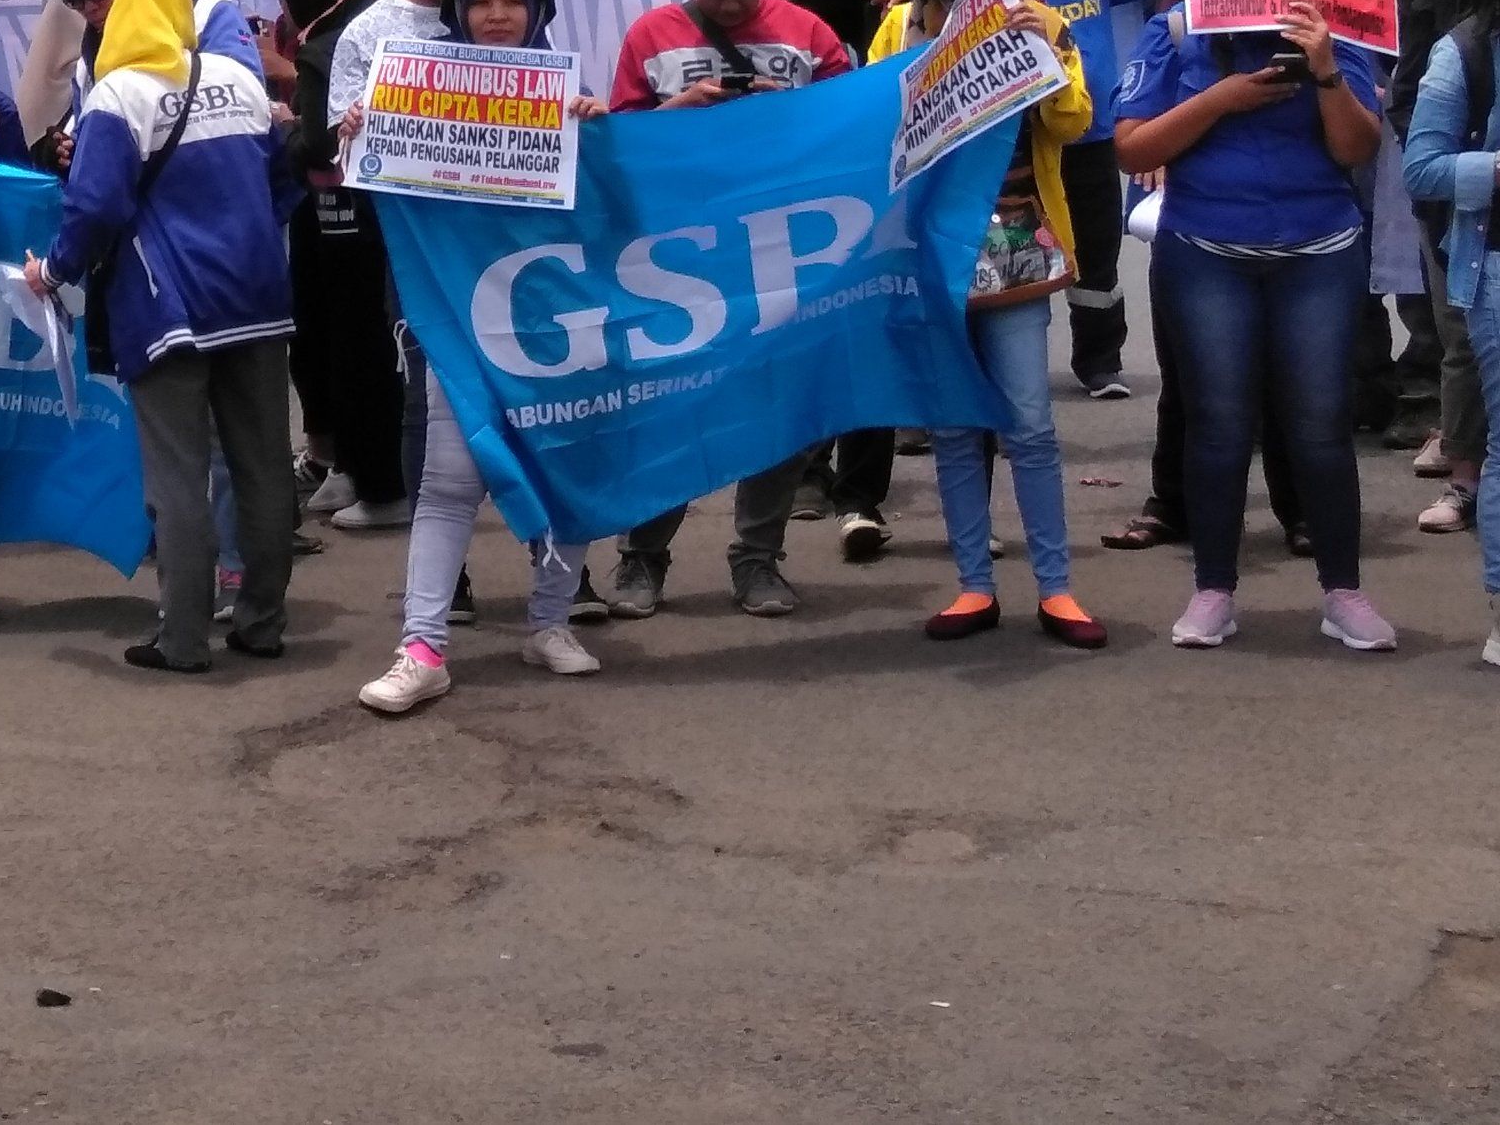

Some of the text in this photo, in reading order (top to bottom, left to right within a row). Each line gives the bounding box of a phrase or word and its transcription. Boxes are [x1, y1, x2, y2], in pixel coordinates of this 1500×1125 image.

[958, 2, 1008, 58] KERJA
[973, 28, 1028, 75] UPAH
[459, 47, 492, 61] BURUH
[379, 56, 564, 100] TOLAK OMNIBUS LAW
[904, 48, 1038, 153] MINIMUM KOTA/KAB
[372, 84, 561, 129] RUU CIPTA KERJA
[366, 114, 562, 153] HILANGKAN SANKSI PIDANA
[366, 137, 560, 173] KEPADA PENGUSAHA PELANGGAR
[506, 388, 622, 429] ABUNGAN
[627, 365, 724, 405] SERIKAT
